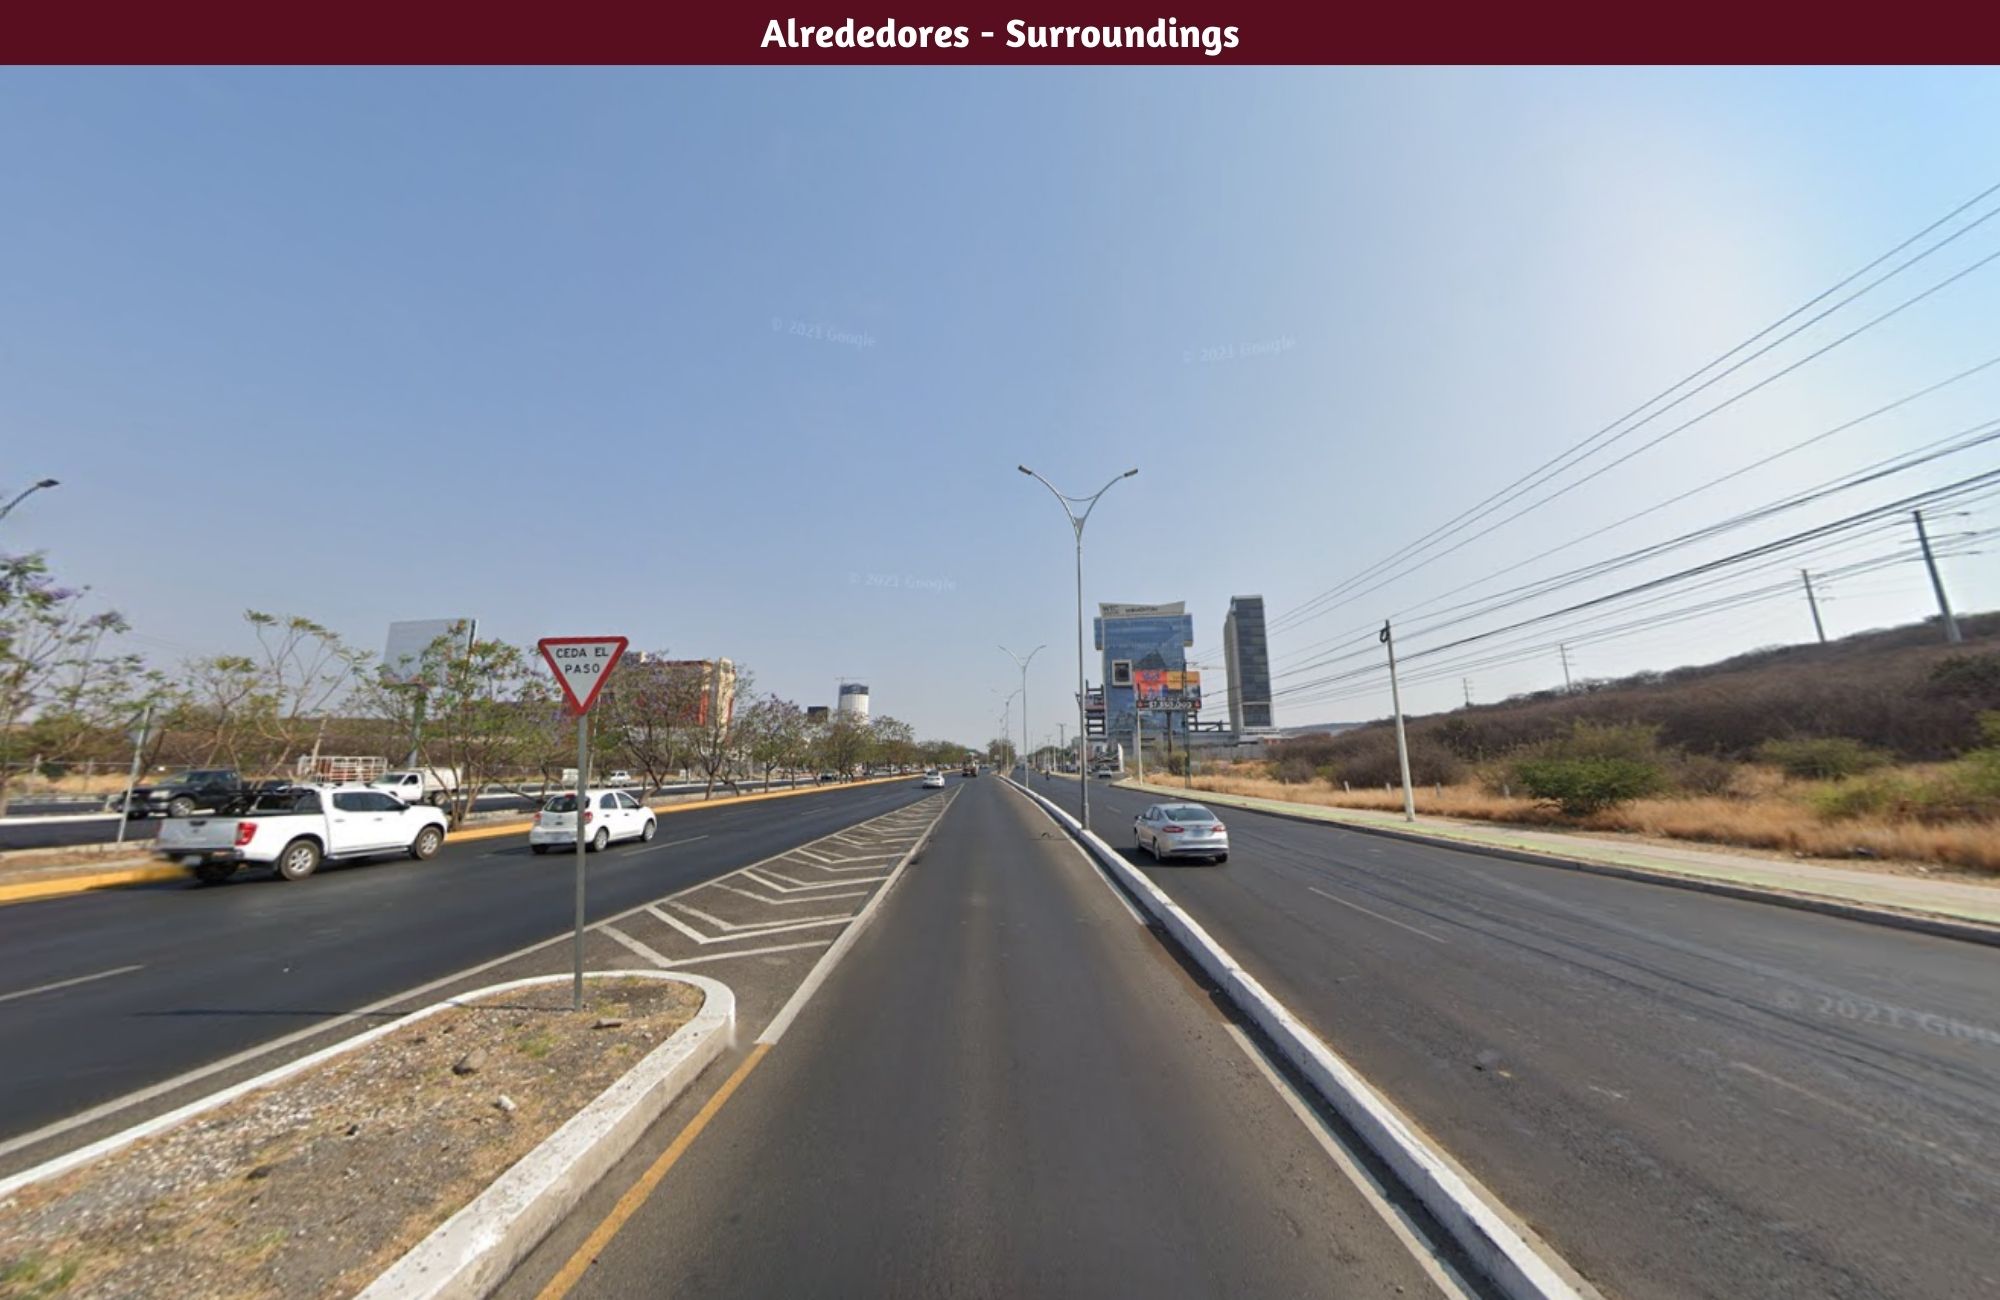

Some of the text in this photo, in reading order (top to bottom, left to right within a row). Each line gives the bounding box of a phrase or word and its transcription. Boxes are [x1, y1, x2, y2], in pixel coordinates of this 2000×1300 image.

[556, 647, 609, 658] CEDA EL
[565, 664, 600, 674] PASO
